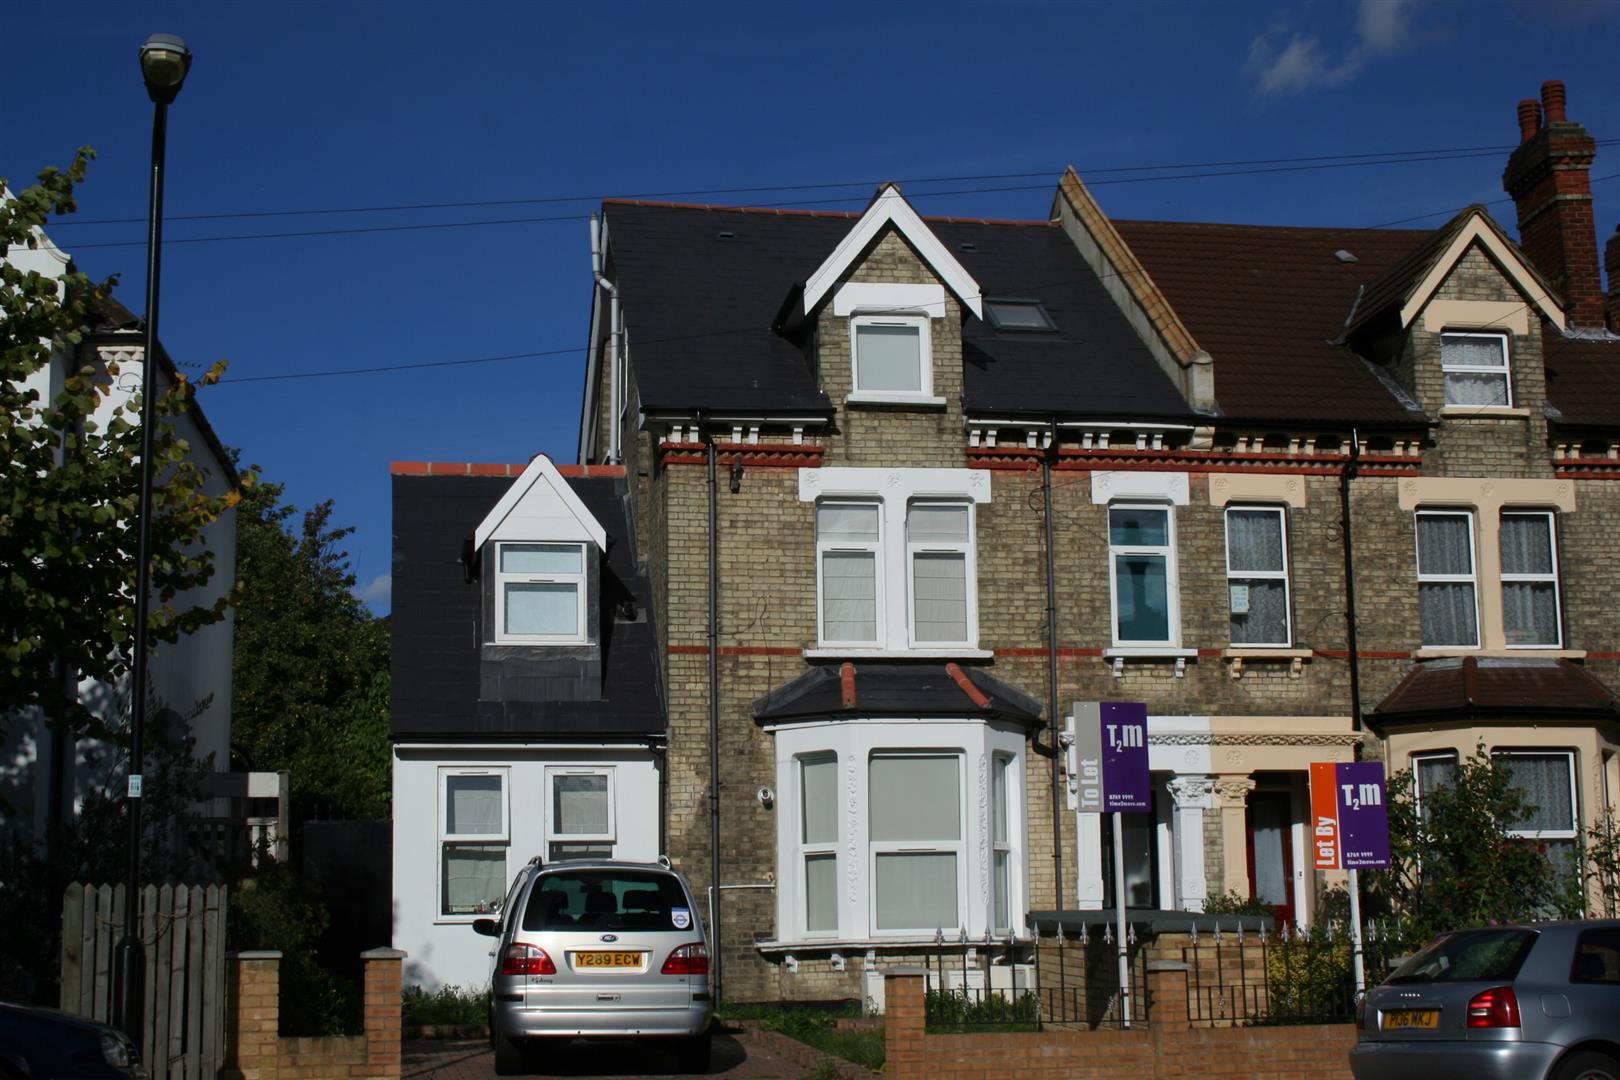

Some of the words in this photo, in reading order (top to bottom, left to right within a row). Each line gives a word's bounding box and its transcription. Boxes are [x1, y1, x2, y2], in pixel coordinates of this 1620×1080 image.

[1080, 758, 1099, 785] Let
[1080, 788, 1100, 808] To
[1315, 816, 1337, 836] By
[1316, 839, 1335, 865] Let
[577, 954, 611, 966] Y289
[614, 954, 640, 965] ECW
